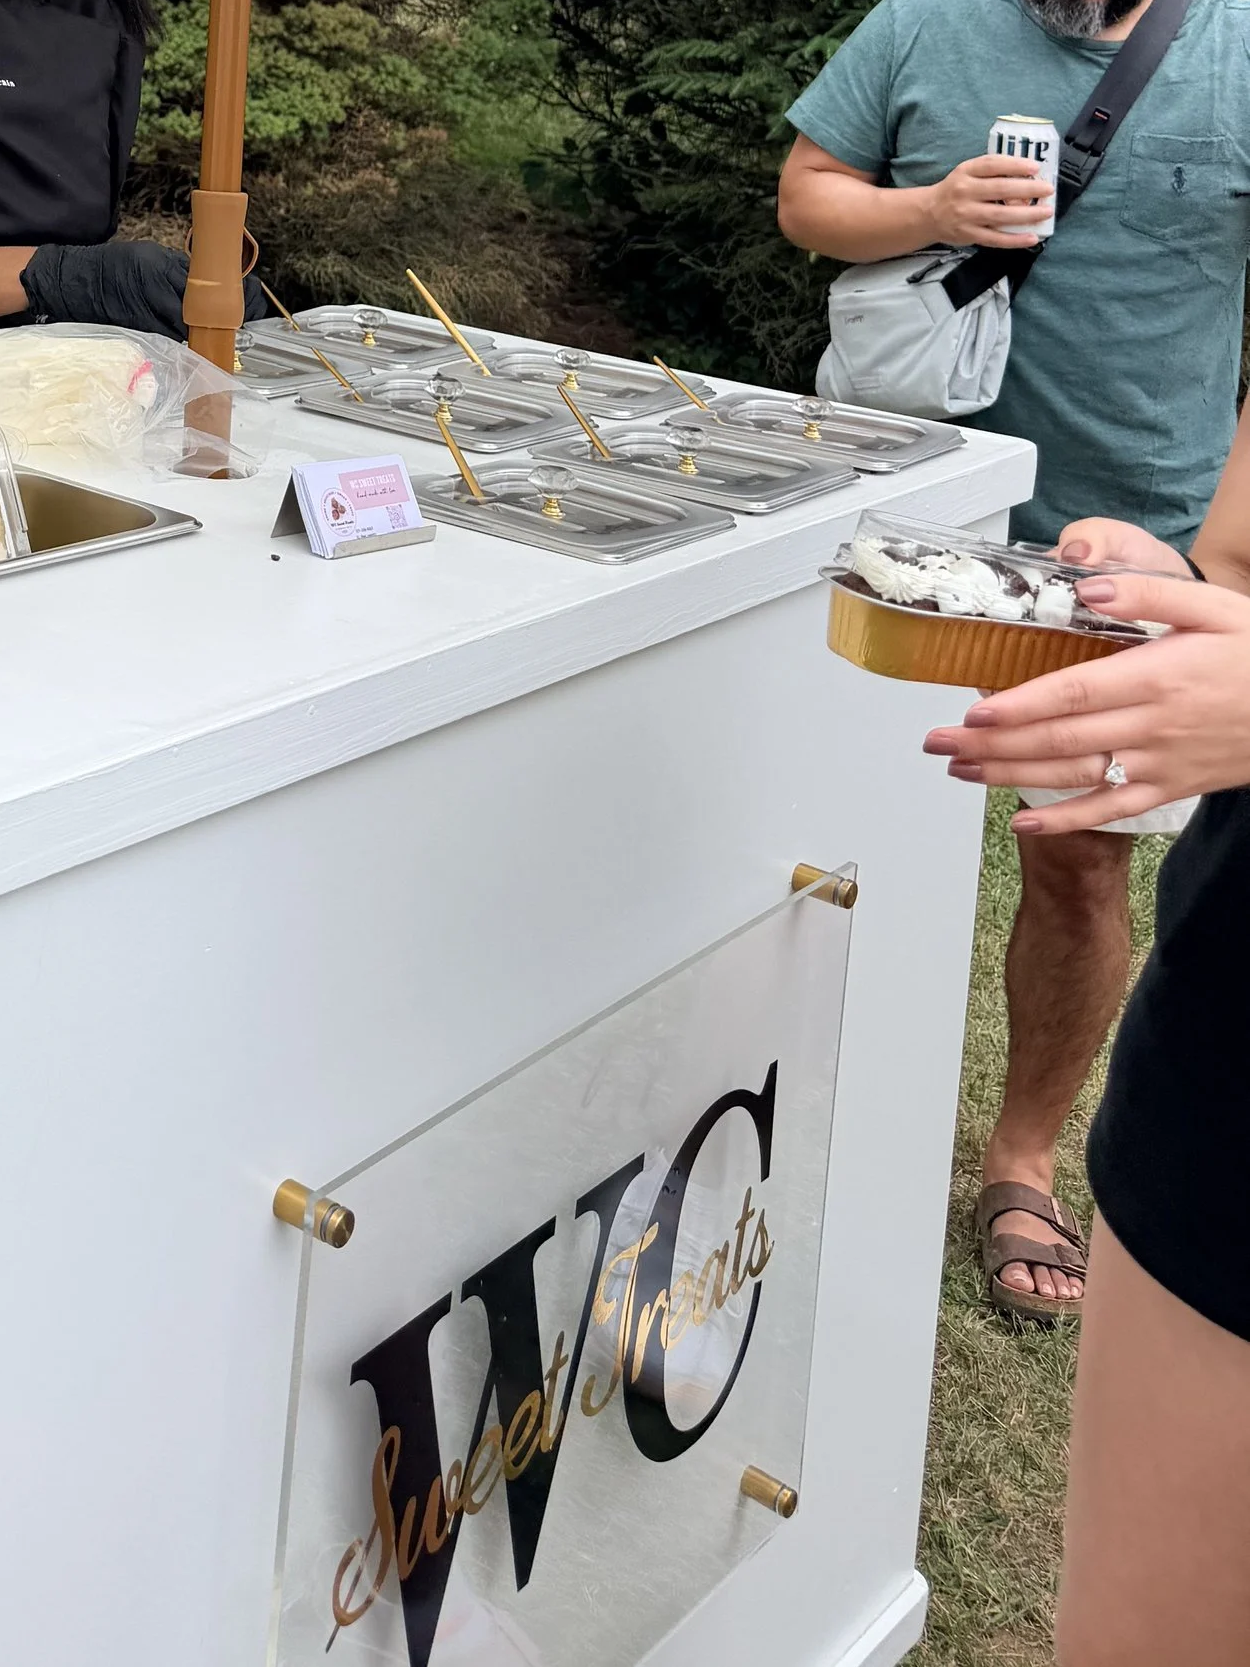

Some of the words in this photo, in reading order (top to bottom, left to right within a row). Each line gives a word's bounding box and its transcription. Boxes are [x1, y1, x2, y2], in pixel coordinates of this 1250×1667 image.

[326, 1331, 569, 1653] Sweet
[581, 1186, 776, 1418] Treats
[350, 1059, 779, 1667] WC
